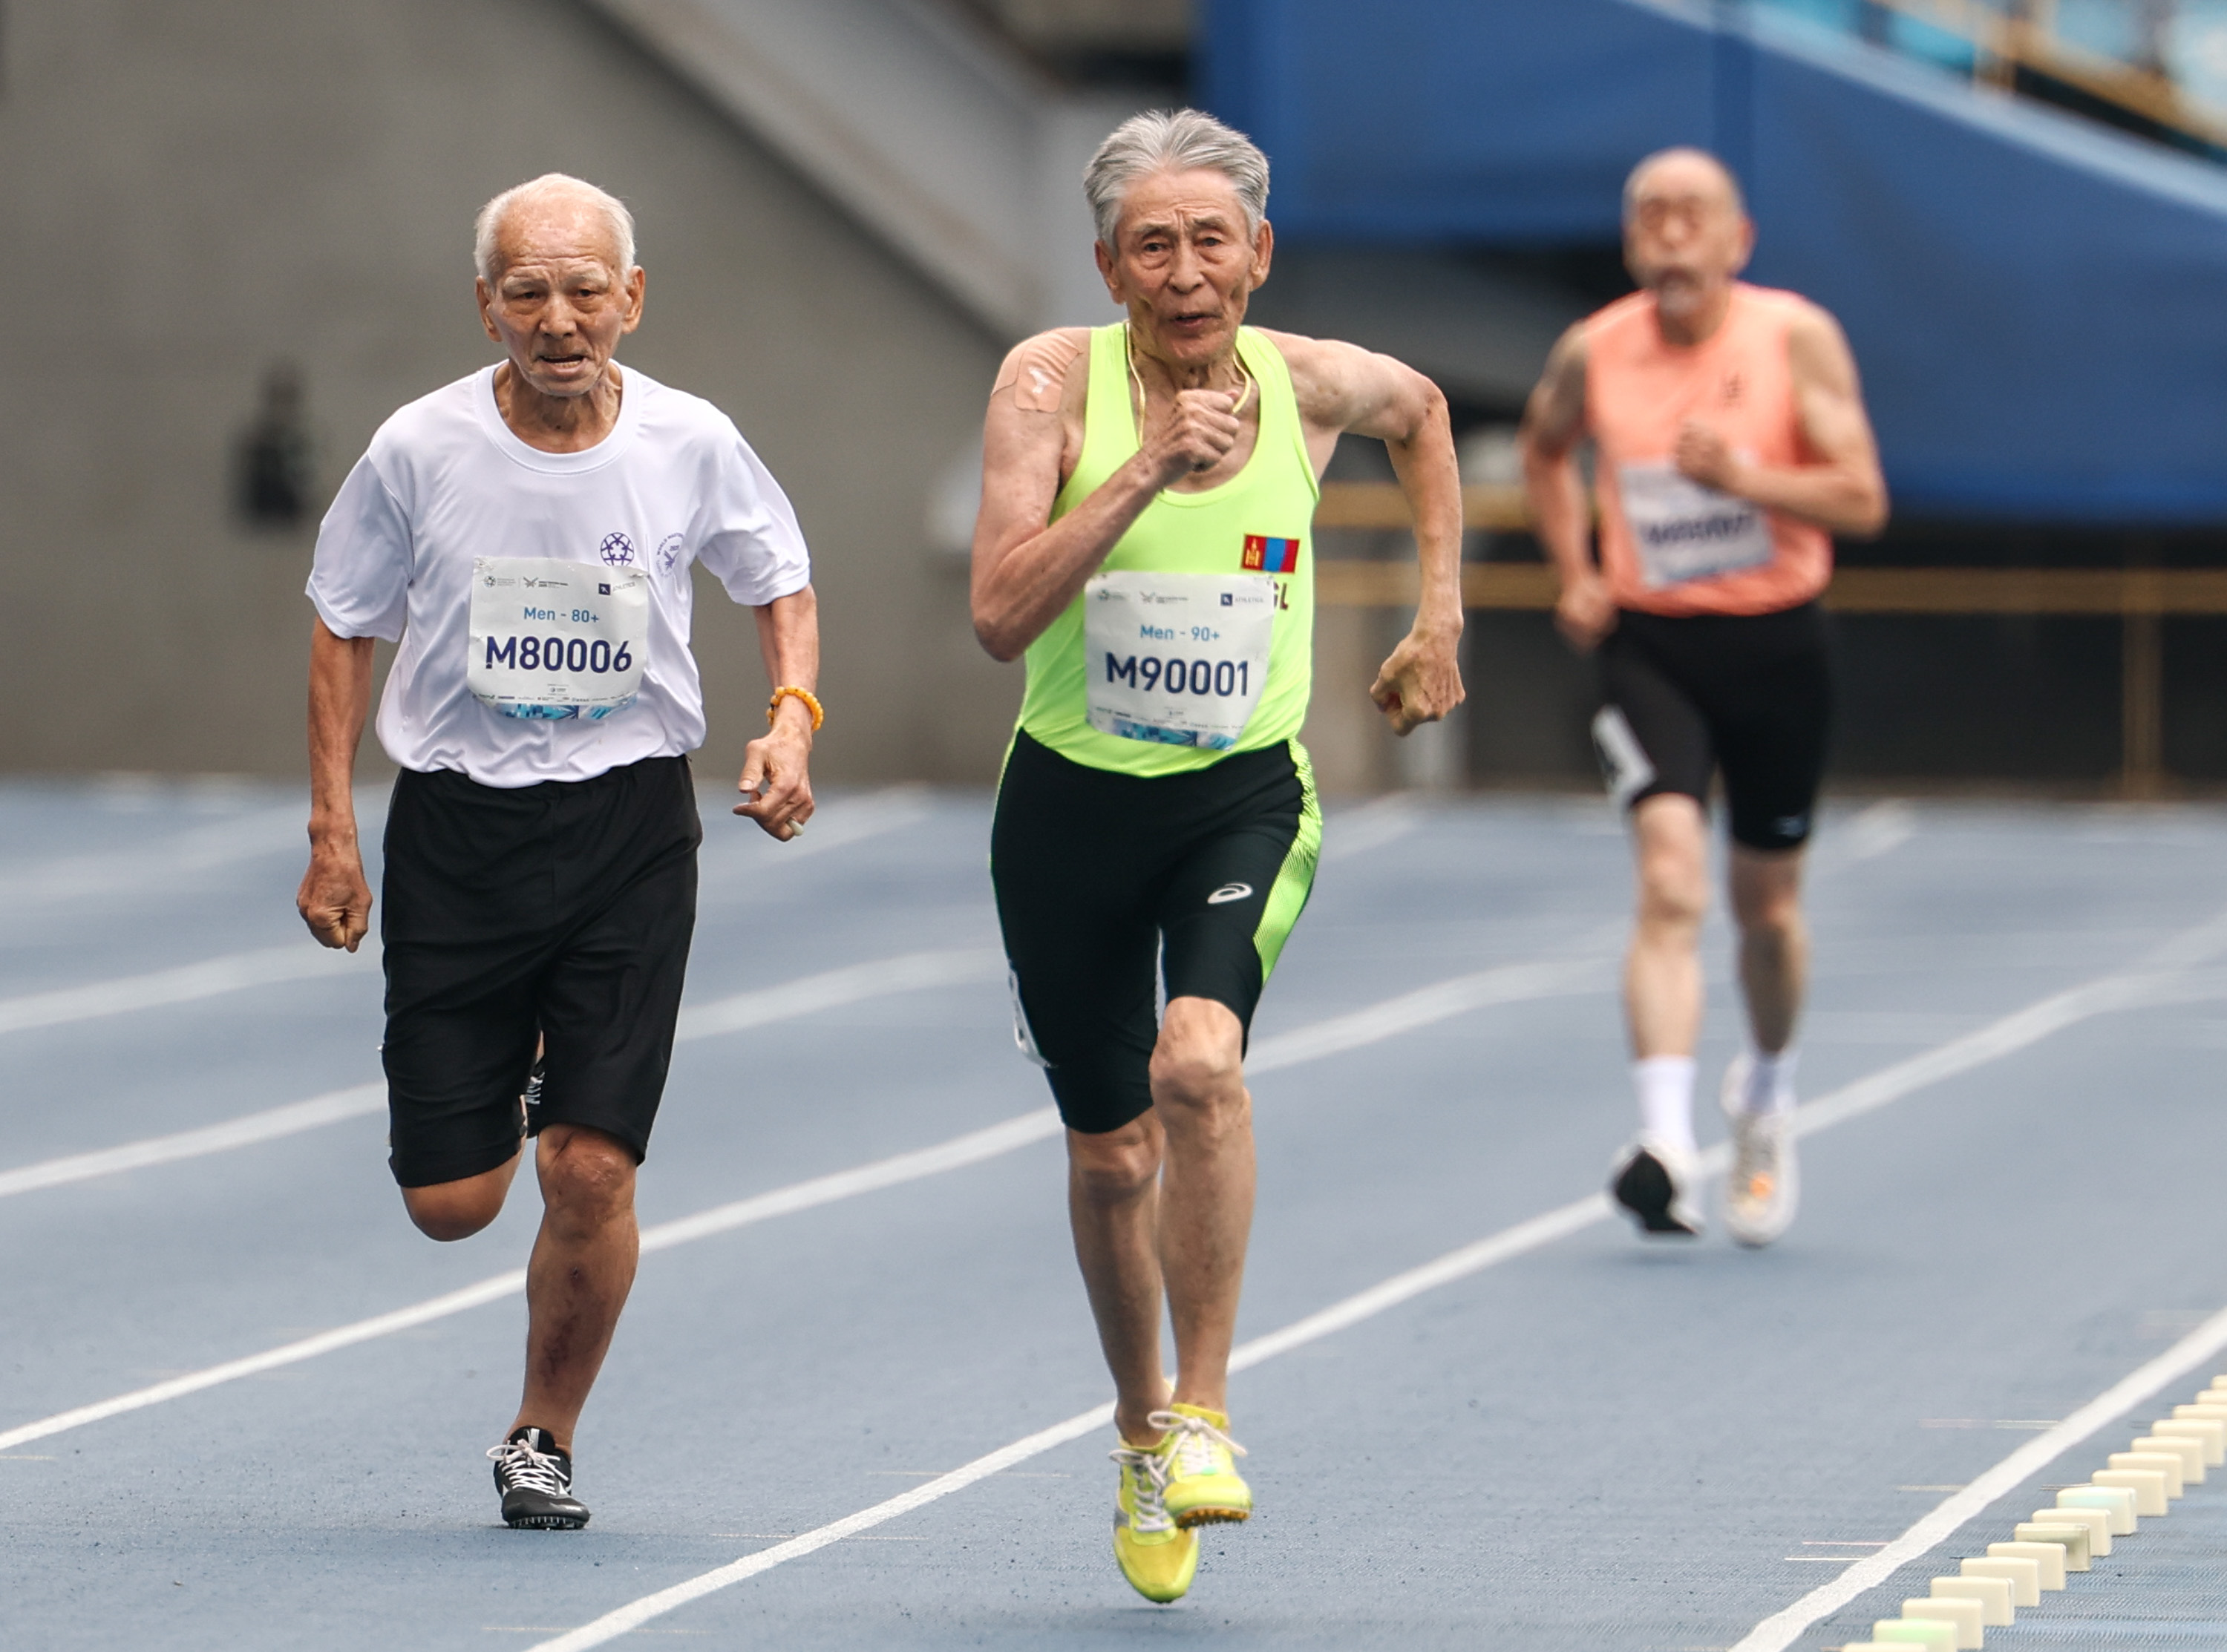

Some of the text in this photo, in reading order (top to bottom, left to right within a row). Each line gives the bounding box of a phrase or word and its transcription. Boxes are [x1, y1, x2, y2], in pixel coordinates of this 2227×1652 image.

[523, 606, 556, 621] Men
[571, 609, 600, 623] 80+
[1139, 623, 1174, 640] Men
[1191, 626, 1220, 642] 90+
[485, 635, 632, 674] M80006
[1104, 651, 1249, 697] M90001
